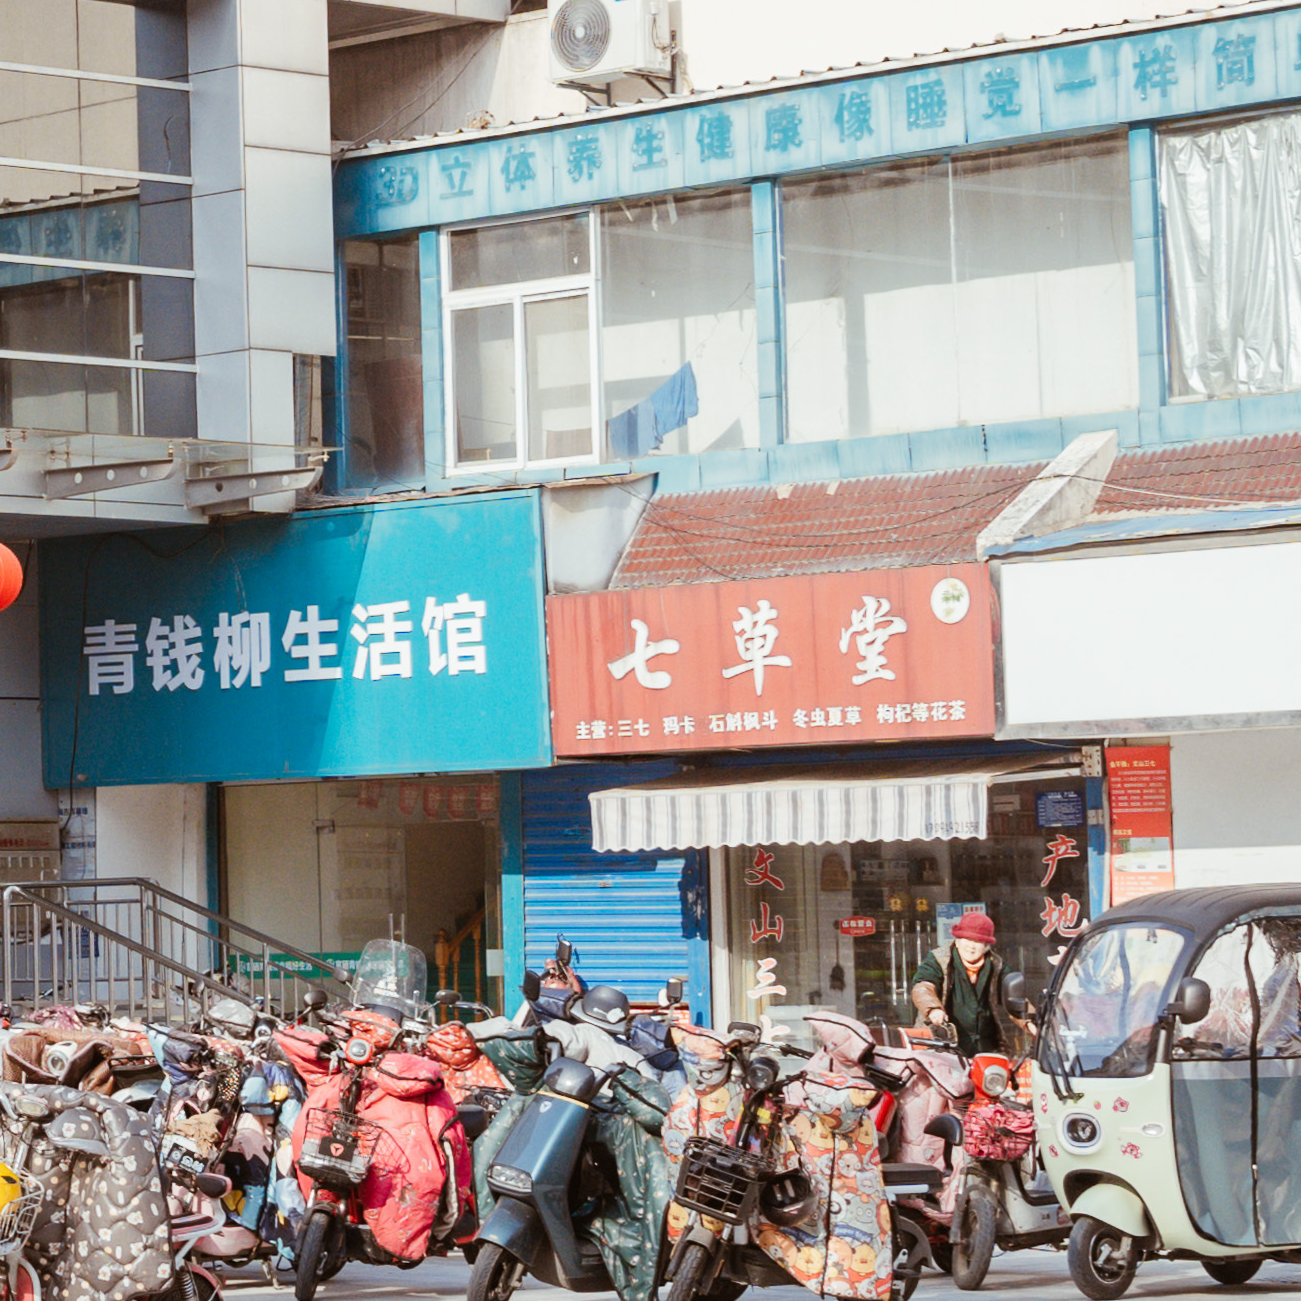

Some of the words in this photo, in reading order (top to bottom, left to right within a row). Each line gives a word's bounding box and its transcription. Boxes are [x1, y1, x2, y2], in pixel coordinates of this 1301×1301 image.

[374, 32, 1301, 207] 3D立体养生健康像睡觉一样简
[83, 592, 488, 696] 青钱柳生活馆
[607, 595, 908, 696] 七草堂
[663, 715, 696, 736] 玛卡
[708, 709, 778, 734] 石斛枫斗
[792, 705, 862, 729] 冬虫夏草
[876, 699, 966, 725] 枸杞等花茶
[1040, 834, 1093, 966] 产地
